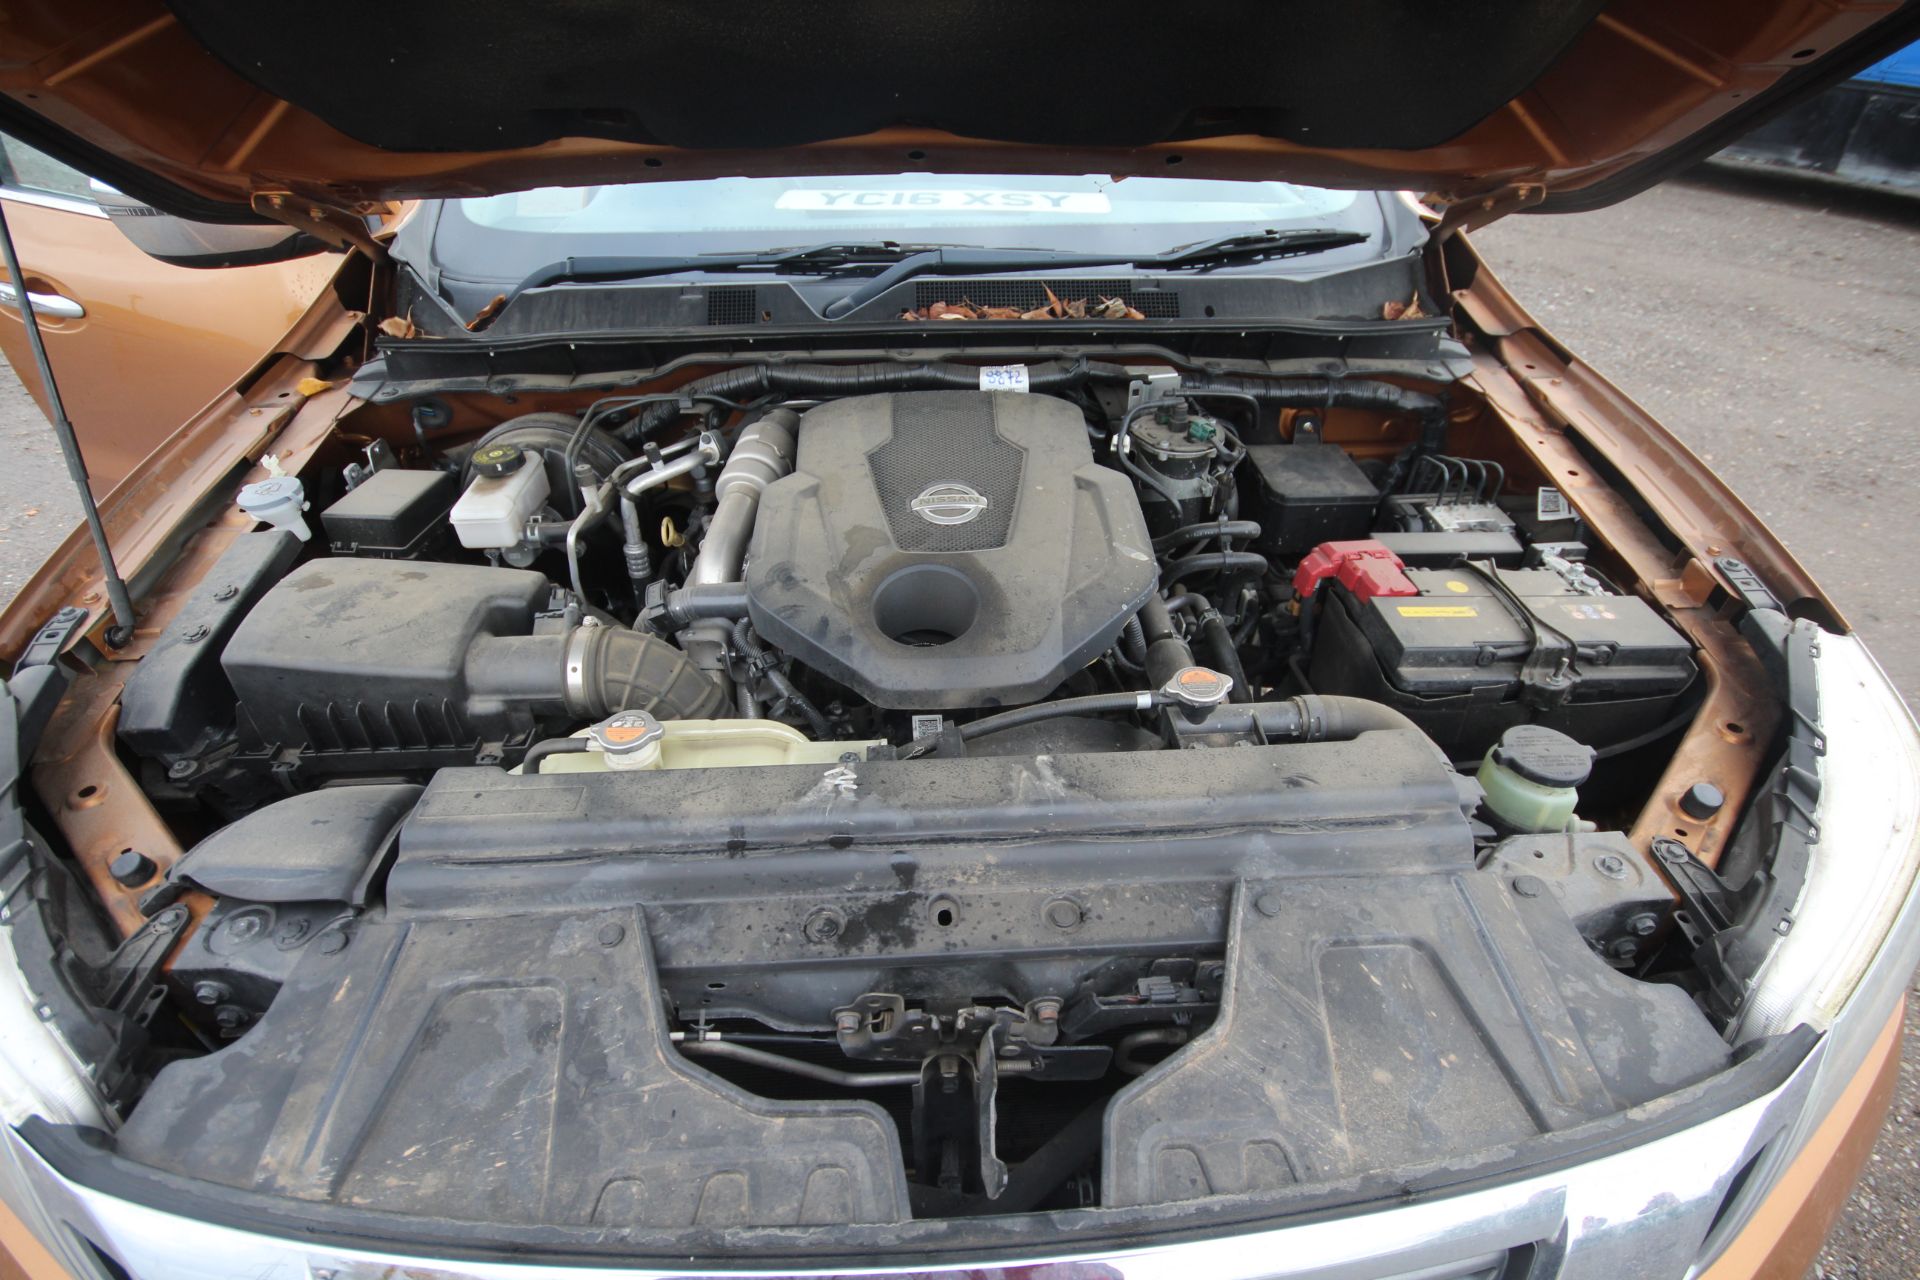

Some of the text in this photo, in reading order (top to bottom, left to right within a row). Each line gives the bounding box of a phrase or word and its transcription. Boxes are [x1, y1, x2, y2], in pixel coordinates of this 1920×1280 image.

[820, 191, 1071, 208] YC16 XSY
[919, 495, 980, 505] NISSAN
